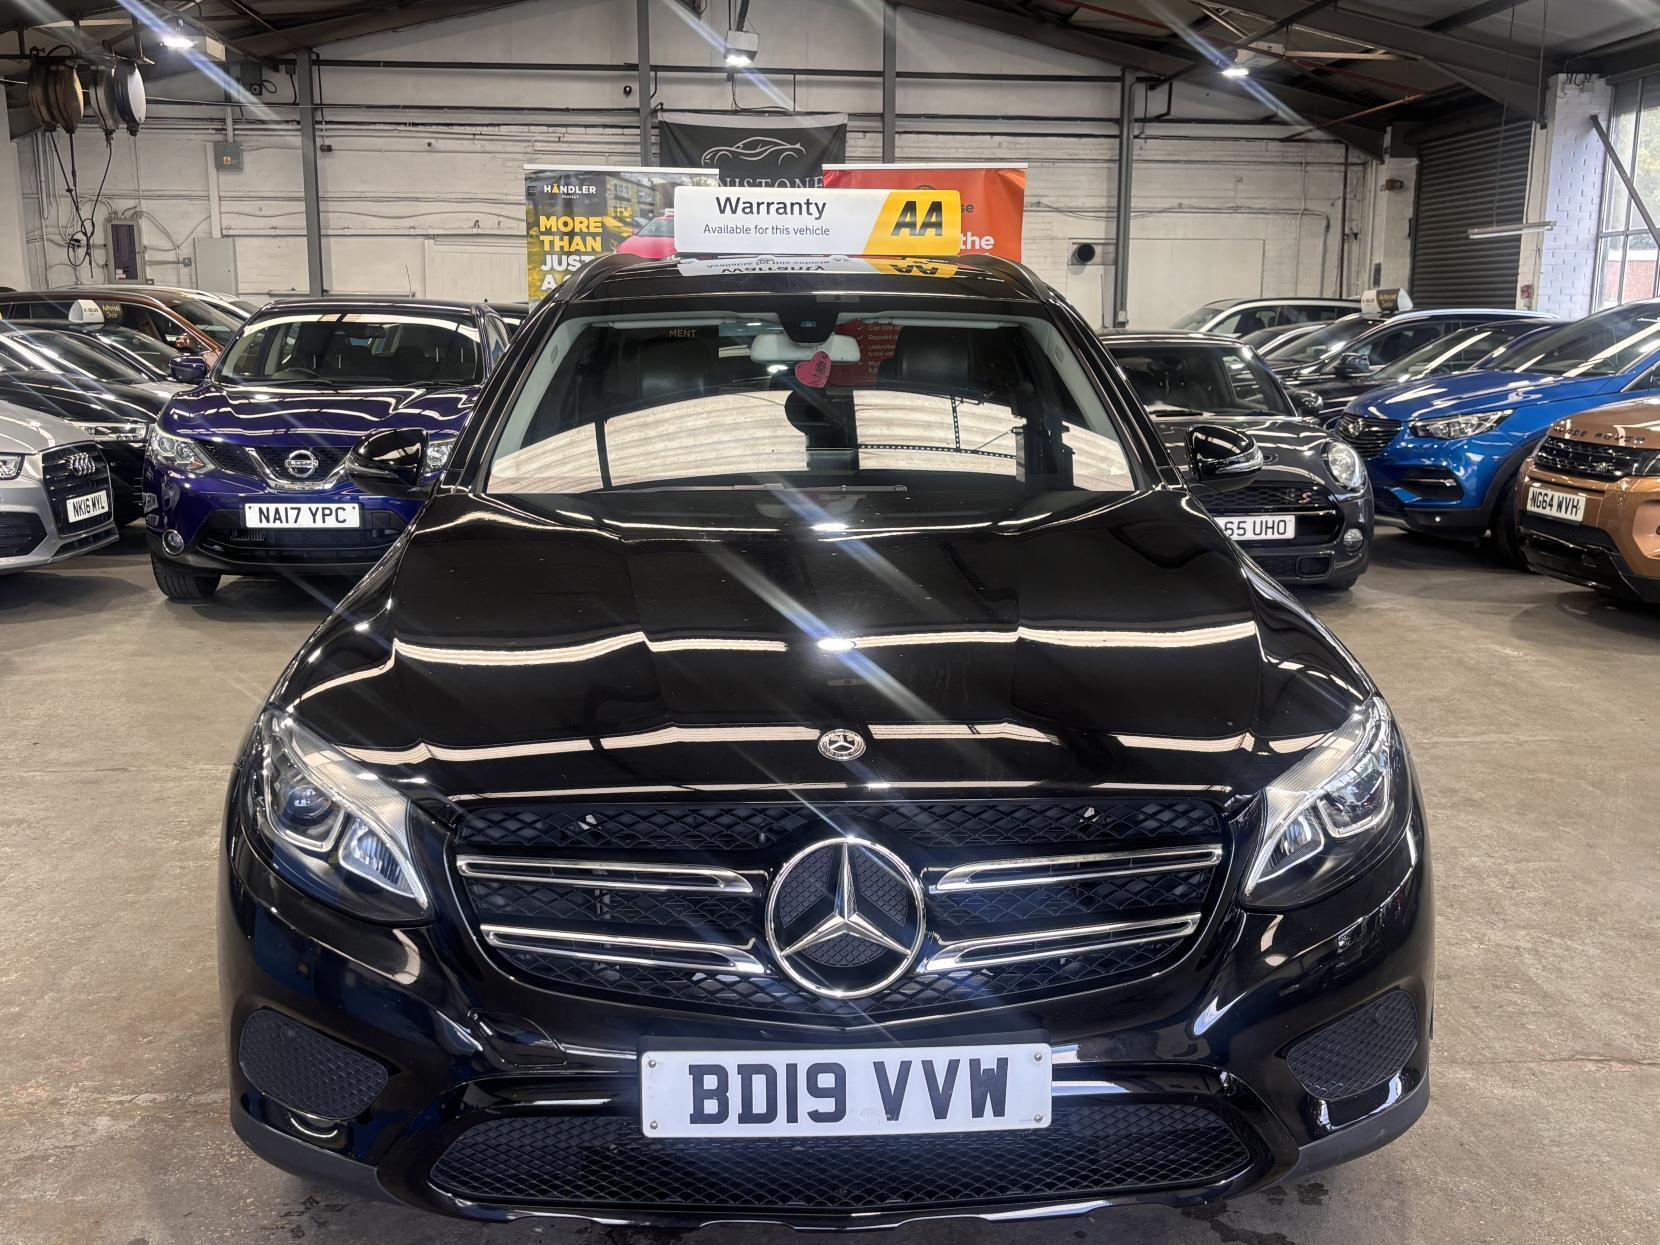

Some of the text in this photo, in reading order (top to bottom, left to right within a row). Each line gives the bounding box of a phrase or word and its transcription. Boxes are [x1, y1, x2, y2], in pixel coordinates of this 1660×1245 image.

[543, 183, 597, 194] HÄNDLER
[716, 196, 826, 220] Warranty
[539, 215, 602, 233] MORE
[891, 200, 943, 236] AA
[703, 224, 830, 236] Available for this vehicle
[539, 235, 602, 252] THAN
[960, 231, 995, 250] the
[669, 329, 697, 338] MENT
[72, 498, 91, 518] NK16
[1530, 490, 1580, 517] NG64 WVH
[258, 506, 347, 524] NA17 YPC
[1252, 519, 1287, 536] UHO
[688, 1056, 1009, 1126] BD19 VVW
